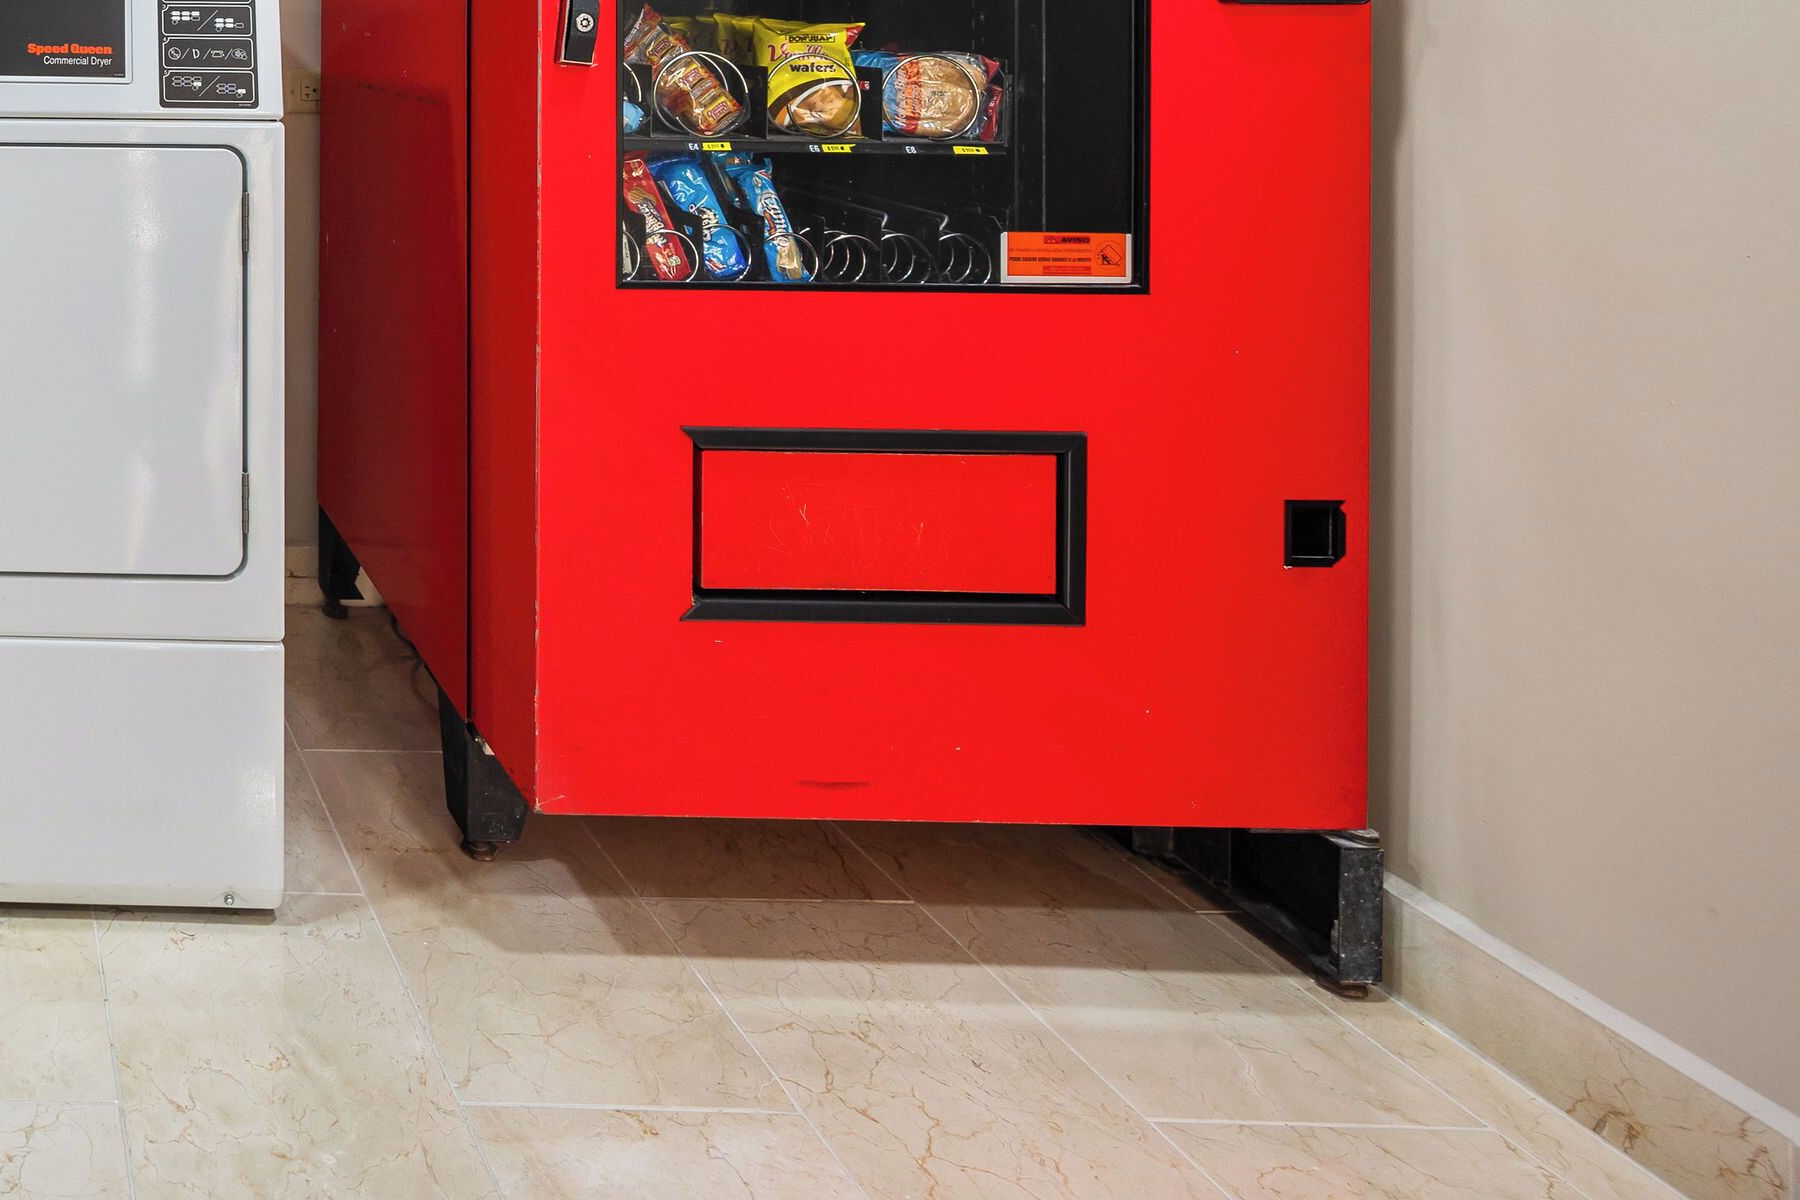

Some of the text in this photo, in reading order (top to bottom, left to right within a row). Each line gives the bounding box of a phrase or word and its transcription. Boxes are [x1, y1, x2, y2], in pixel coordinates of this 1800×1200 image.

[788, 35, 807, 43] DON
[27, 43, 112, 55] Speed Queen
[43, 55, 112, 67] Commercial Dryer
[790, 62, 836, 73] wafers
[809, 144, 821, 152] E6
